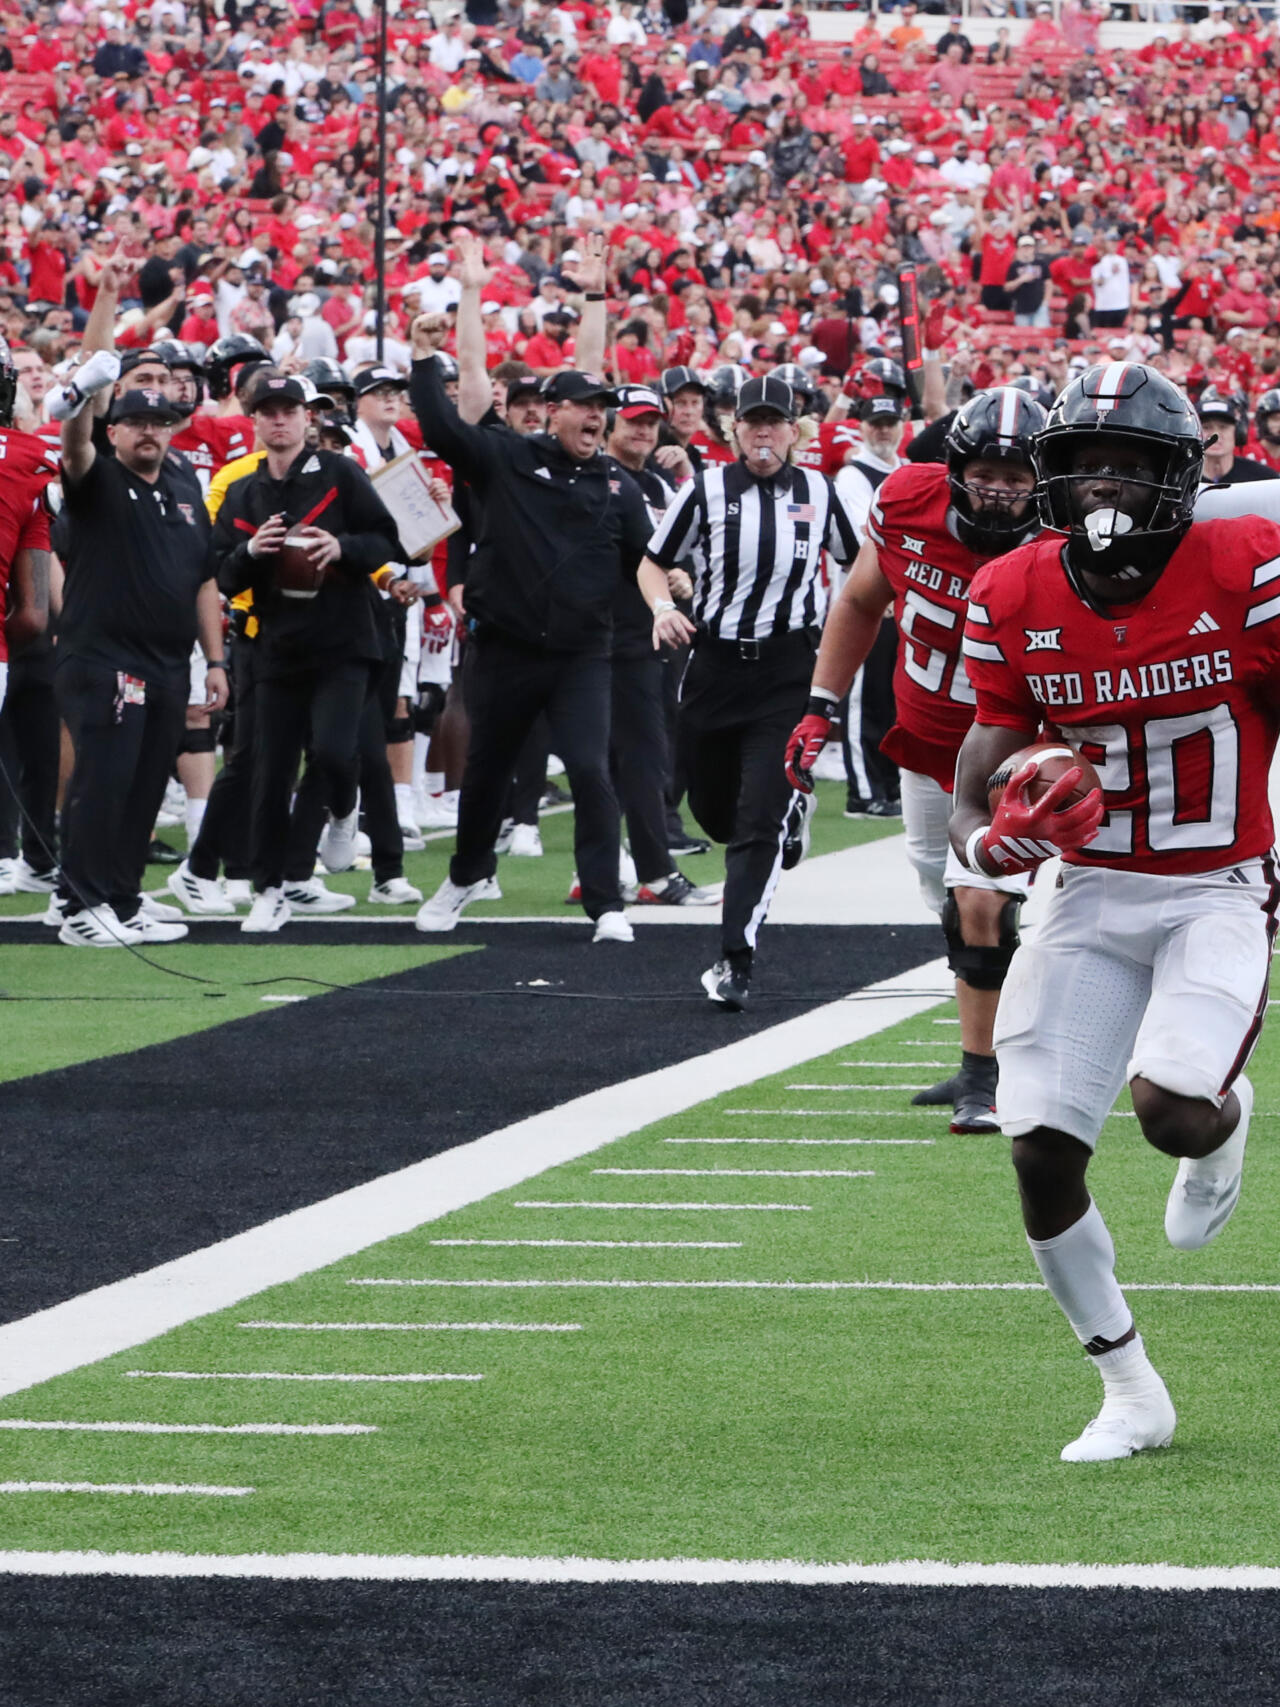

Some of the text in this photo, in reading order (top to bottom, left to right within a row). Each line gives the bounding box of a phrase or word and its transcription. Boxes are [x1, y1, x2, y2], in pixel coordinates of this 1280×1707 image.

[727, 502, 740, 516] S
[795, 540, 809, 559] H
[904, 560, 943, 591] RED
[1025, 628, 1062, 652] XII
[1025, 649, 1233, 705] RED RAIDERS
[1056, 702, 1238, 854] 20
